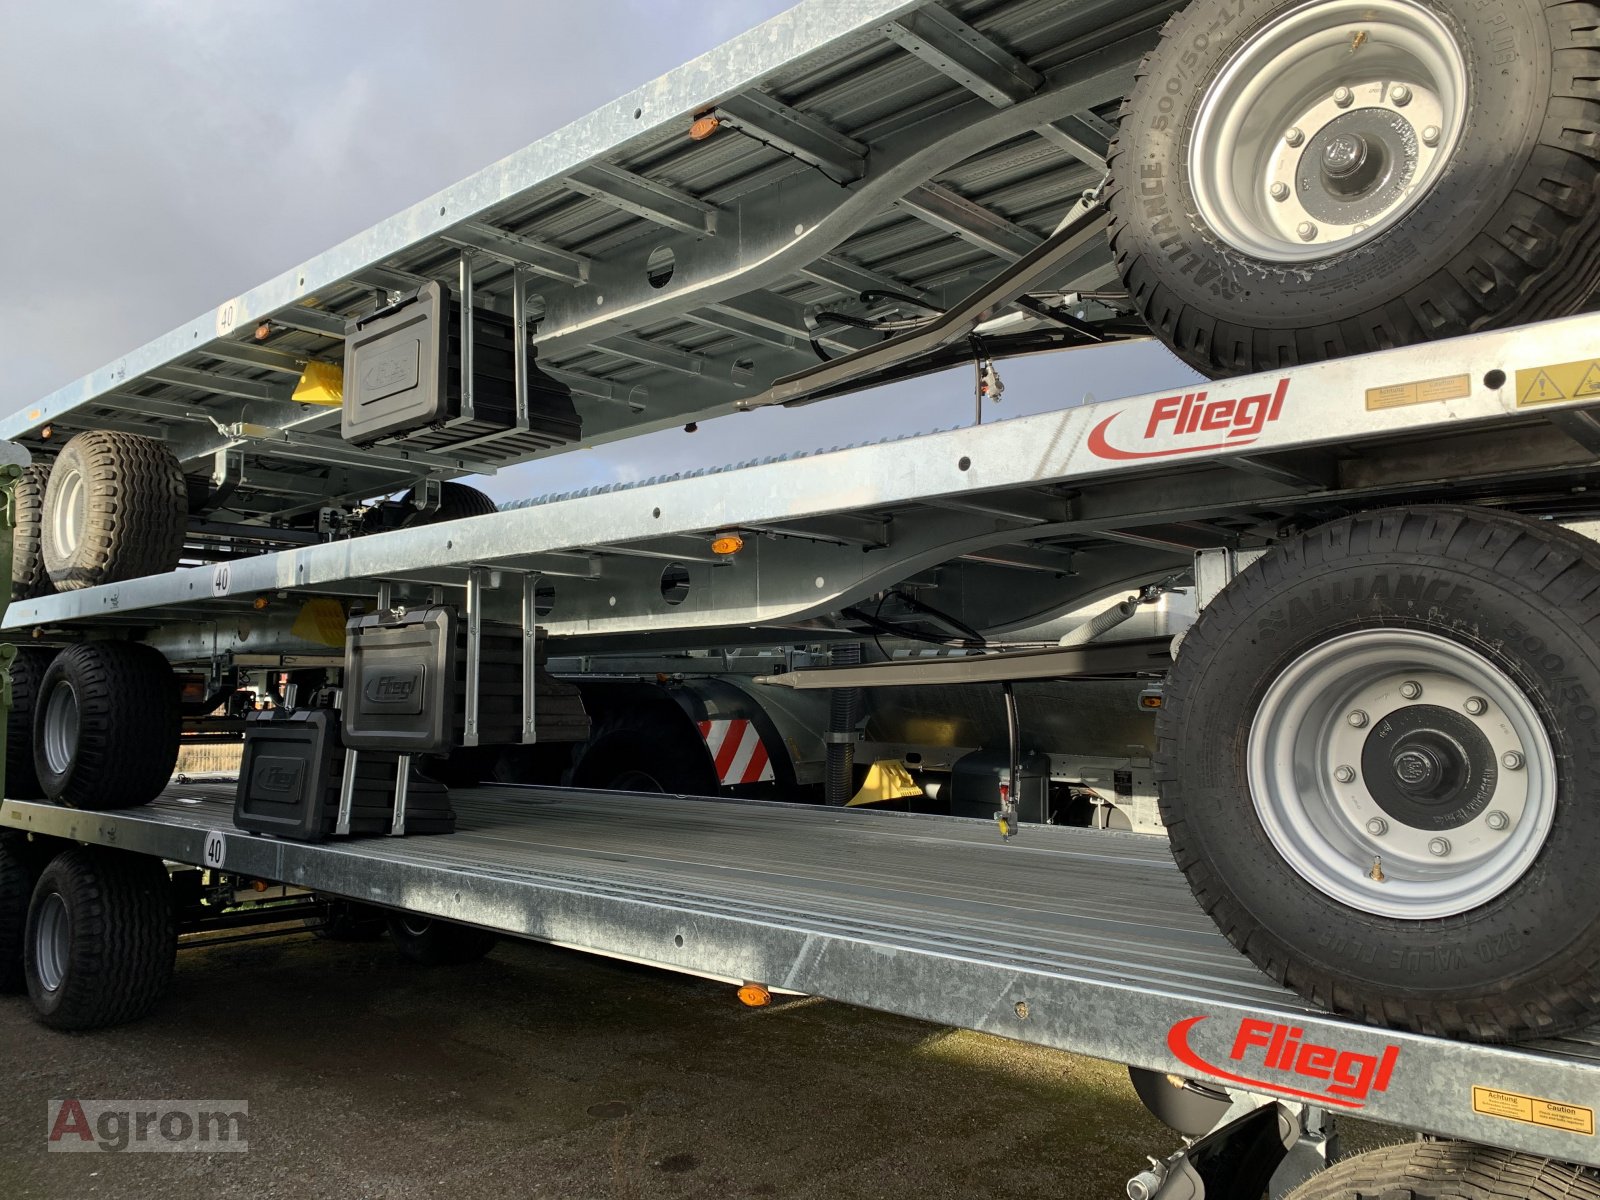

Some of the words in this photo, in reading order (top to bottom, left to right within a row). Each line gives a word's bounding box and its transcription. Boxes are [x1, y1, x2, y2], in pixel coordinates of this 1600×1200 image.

[1139, 162, 1223, 288] ALLIANCE
[221, 306, 233, 328] 40
[1144, 378, 1292, 438] Fliegl
[215, 567, 228, 591] 40
[1288, 574, 1475, 630] ALLIANCE
[208, 838, 222, 864] 40
[1229, 1017, 1400, 1100] Fliegl
[1488, 1091, 1518, 1104] Achtung
[1546, 1103, 1577, 1116] Caution
